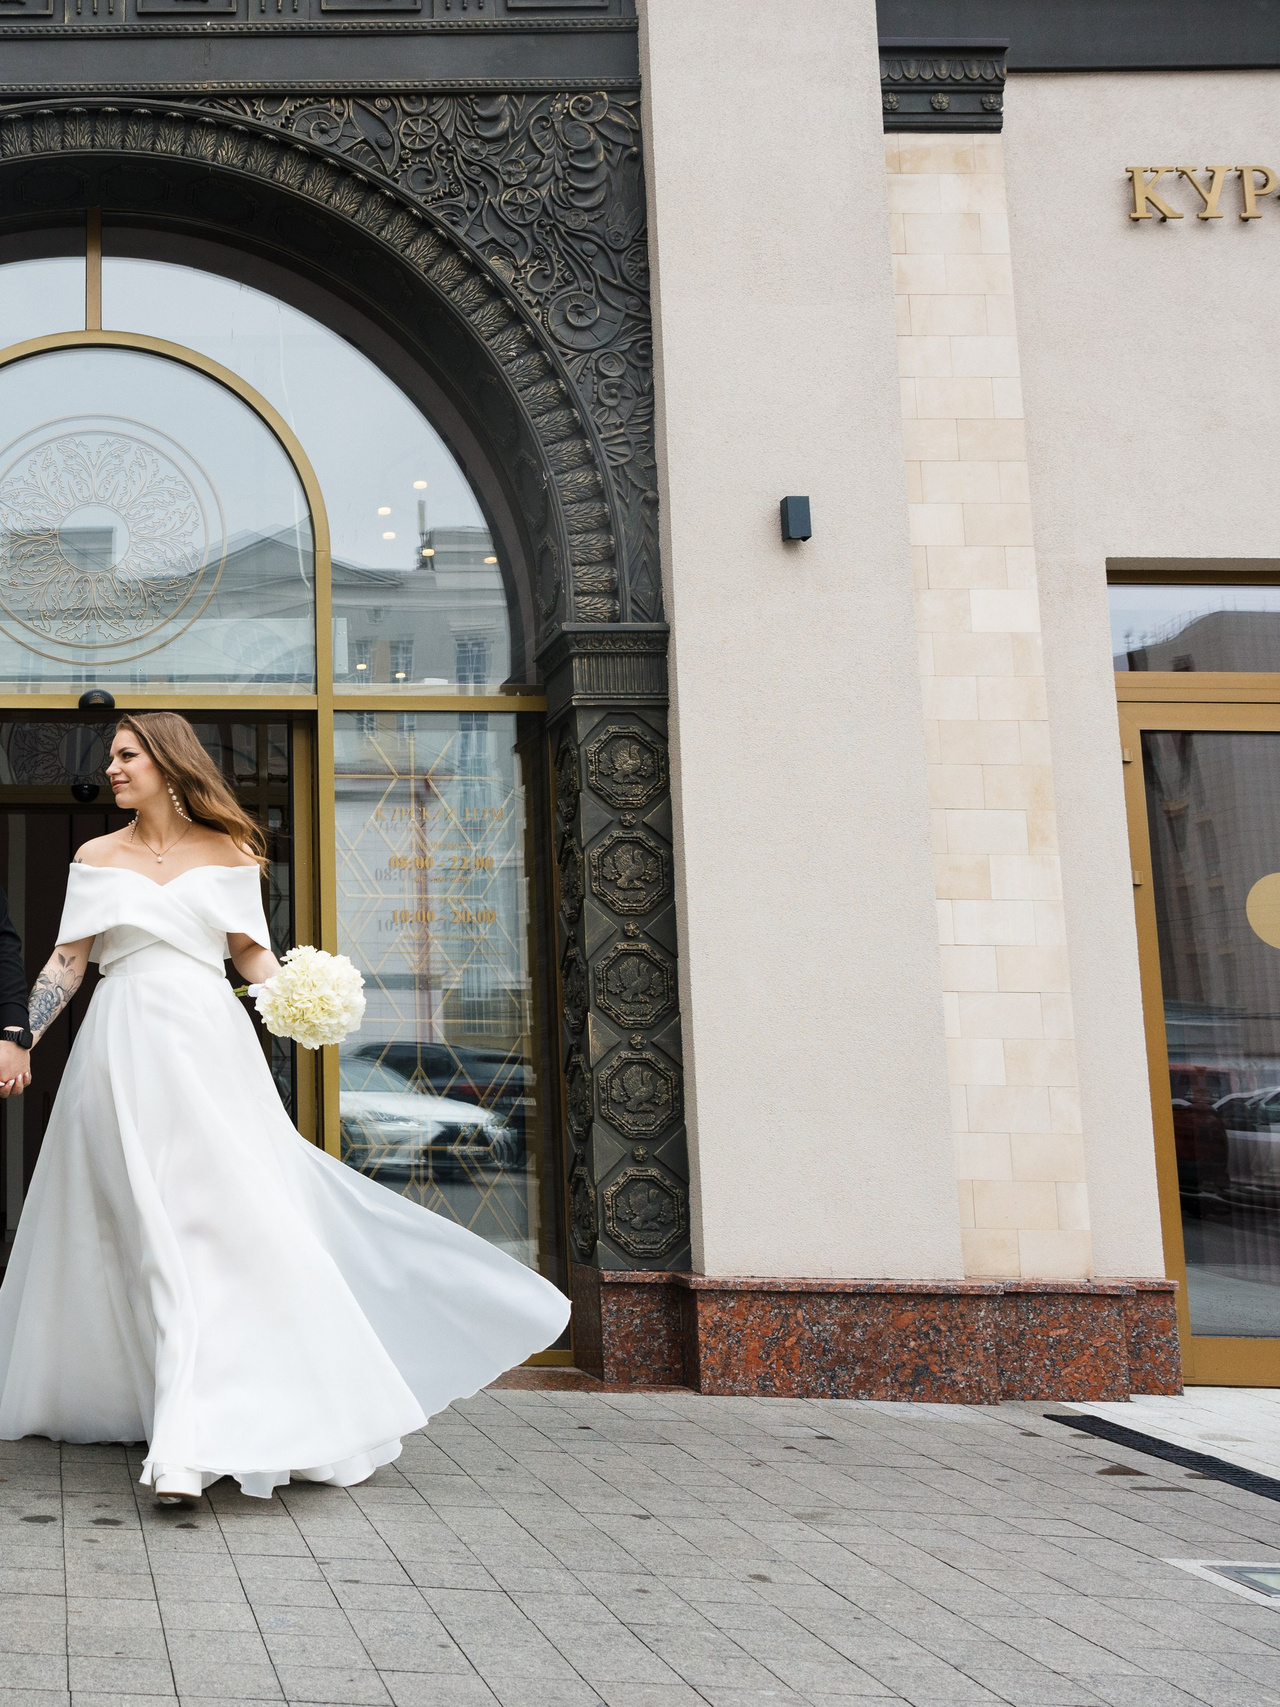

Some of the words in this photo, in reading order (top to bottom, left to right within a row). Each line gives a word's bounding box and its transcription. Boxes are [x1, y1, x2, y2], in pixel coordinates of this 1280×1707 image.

[1125, 165, 1279, 219] КУР
[389, 855, 433, 870] 08:00
[449, 855, 494, 870] 22:00
[392, 909, 435, 923] 10:00
[452, 909, 496, 923] 20:00
